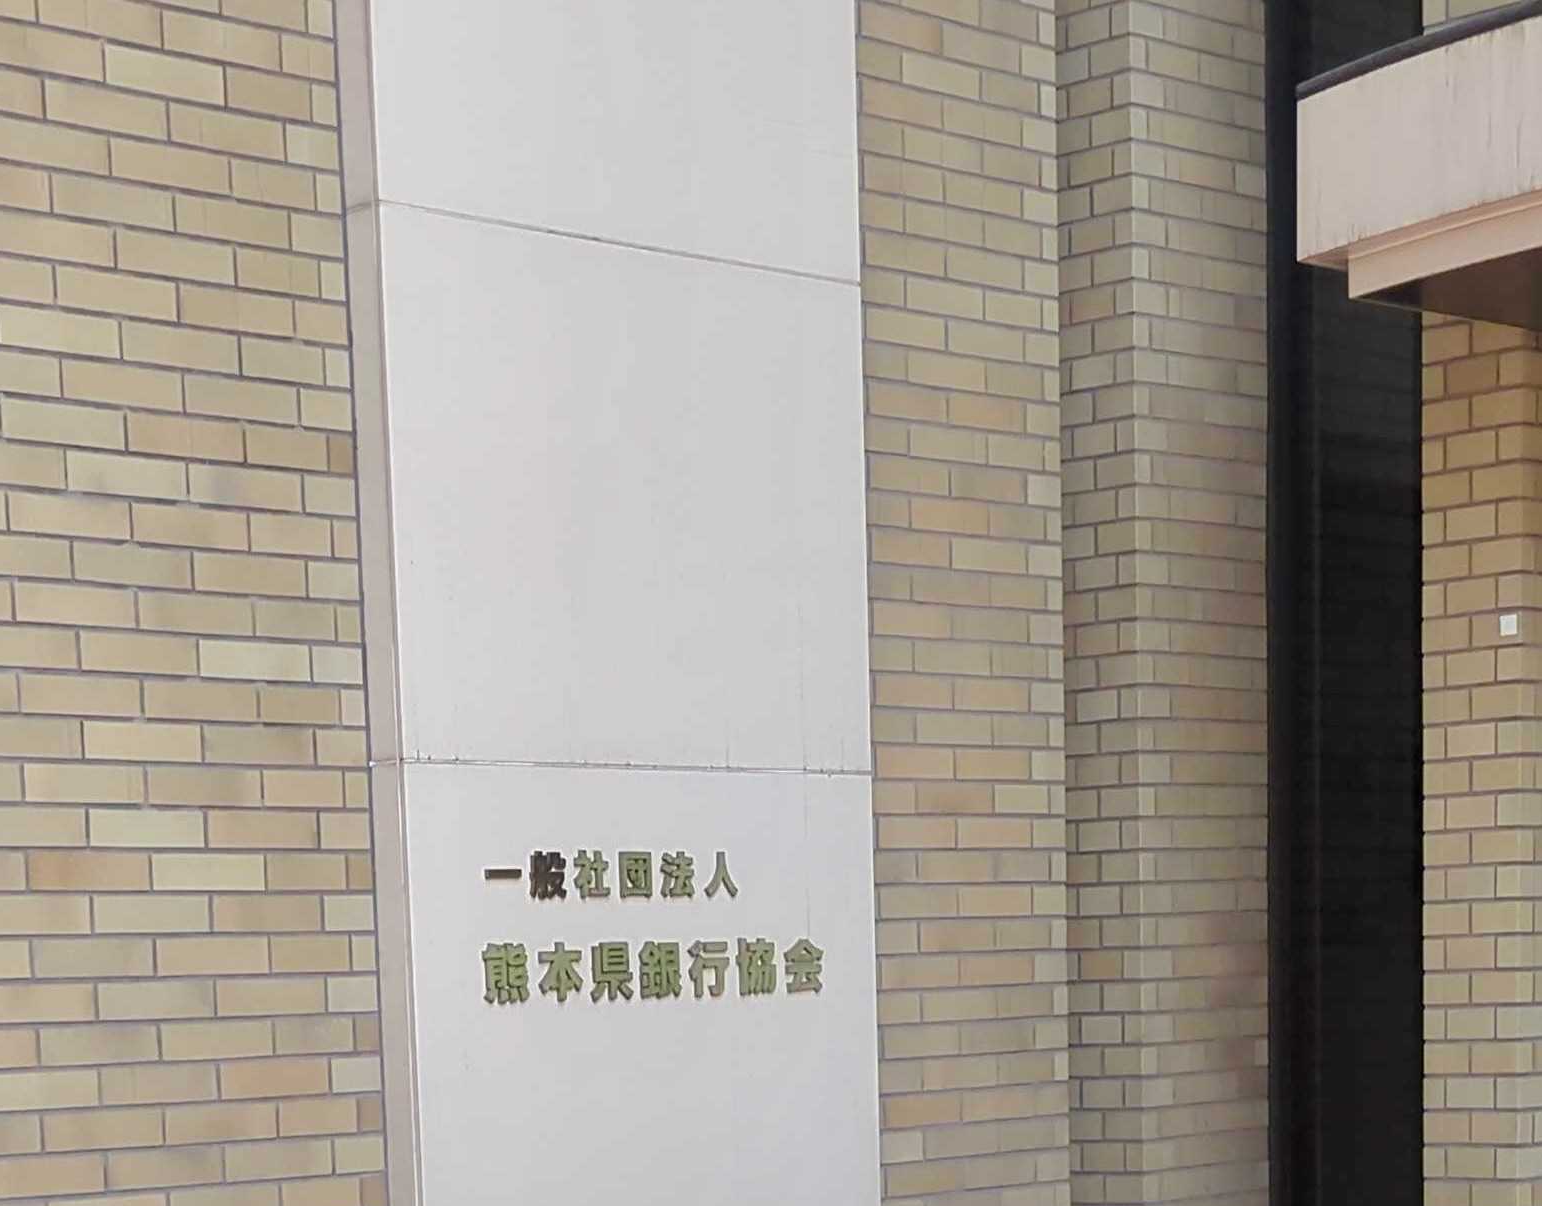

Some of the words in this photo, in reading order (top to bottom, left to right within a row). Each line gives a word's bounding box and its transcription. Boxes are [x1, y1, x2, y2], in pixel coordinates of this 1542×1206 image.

[484, 850, 739, 900] 一般社団法人
[482, 937, 825, 1005] 熊本県銀行協会
